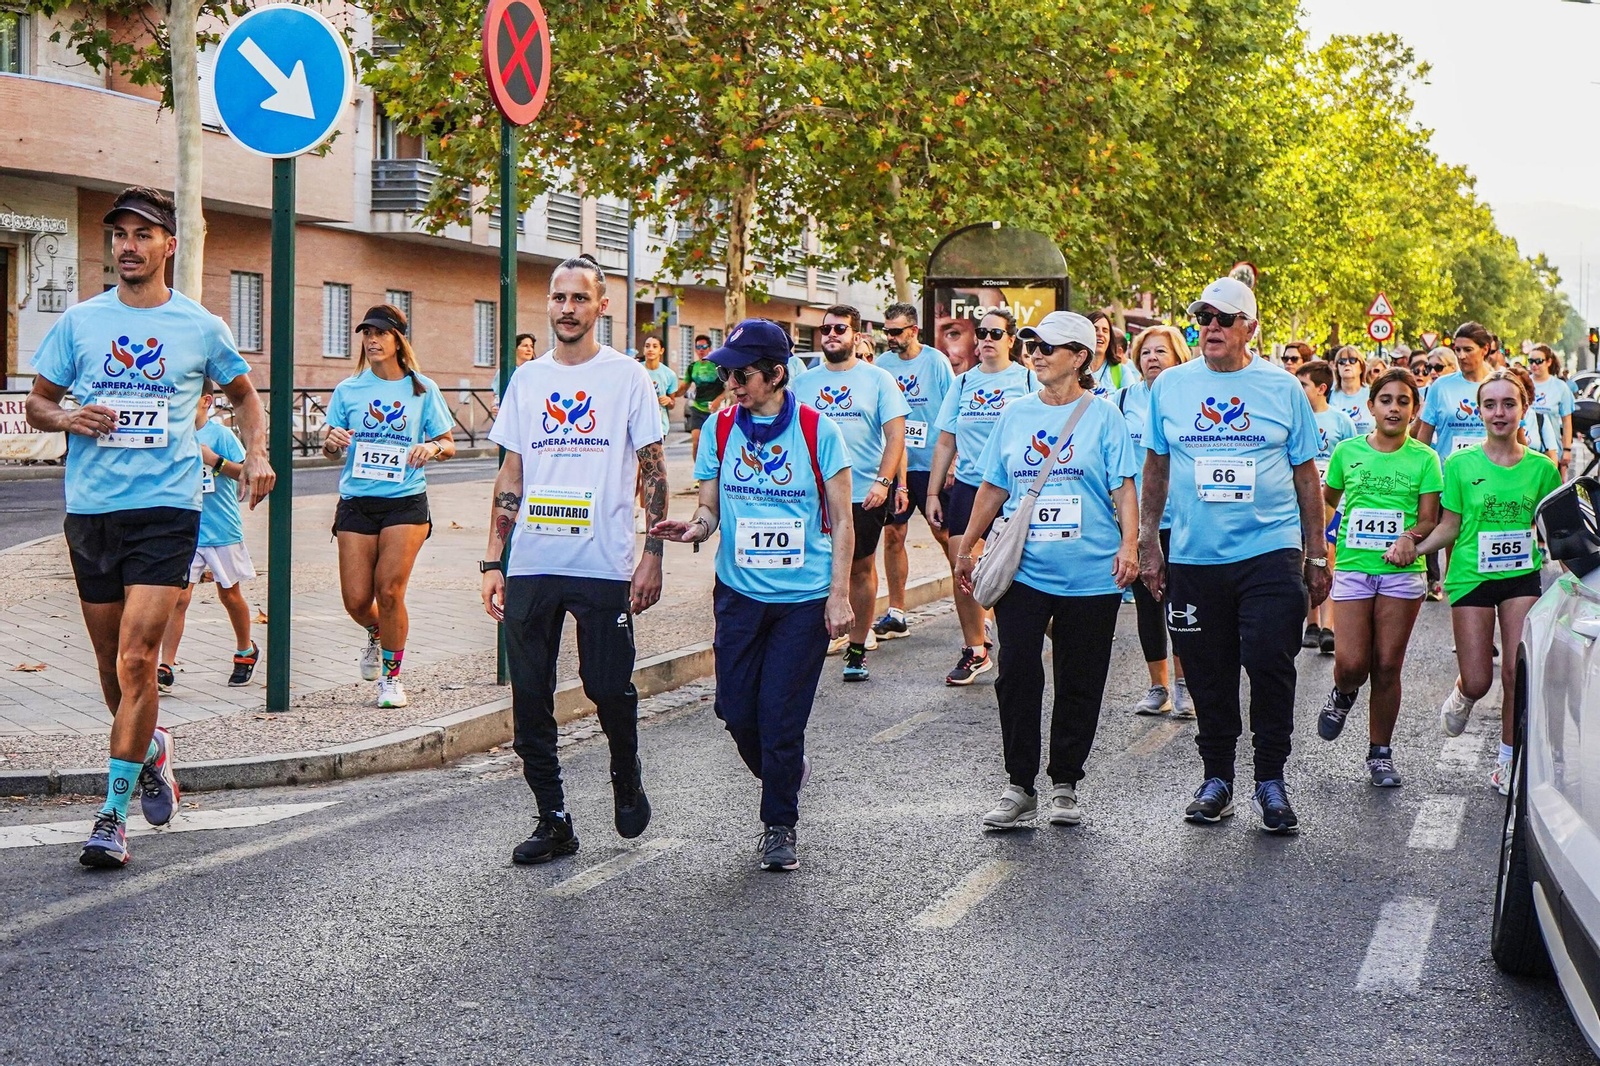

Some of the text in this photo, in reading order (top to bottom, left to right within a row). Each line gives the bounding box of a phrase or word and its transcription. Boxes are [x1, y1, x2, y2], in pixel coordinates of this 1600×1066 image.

[1374, 325, 1389, 334] 30
[92, 381, 176, 394] CARRERA-MARCHA
[112, 411, 158, 426] 577
[1178, 434, 1267, 443] CARRERA-MARCHA
[362, 451, 400, 465] 1574
[1013, 467, 1084, 478] CARRE-MARCHA
[1212, 469, 1236, 483] 66
[723, 483, 806, 498] CARRERA-MARCHA
[752, 495, 775, 503] ASPACE
[529, 505, 589, 519] VOLUNTARIO
[1038, 508, 1061, 523] 67
[1355, 519, 1398, 533] 1413
[750, 532, 790, 548] 170
[1491, 541, 1523, 556] 565
